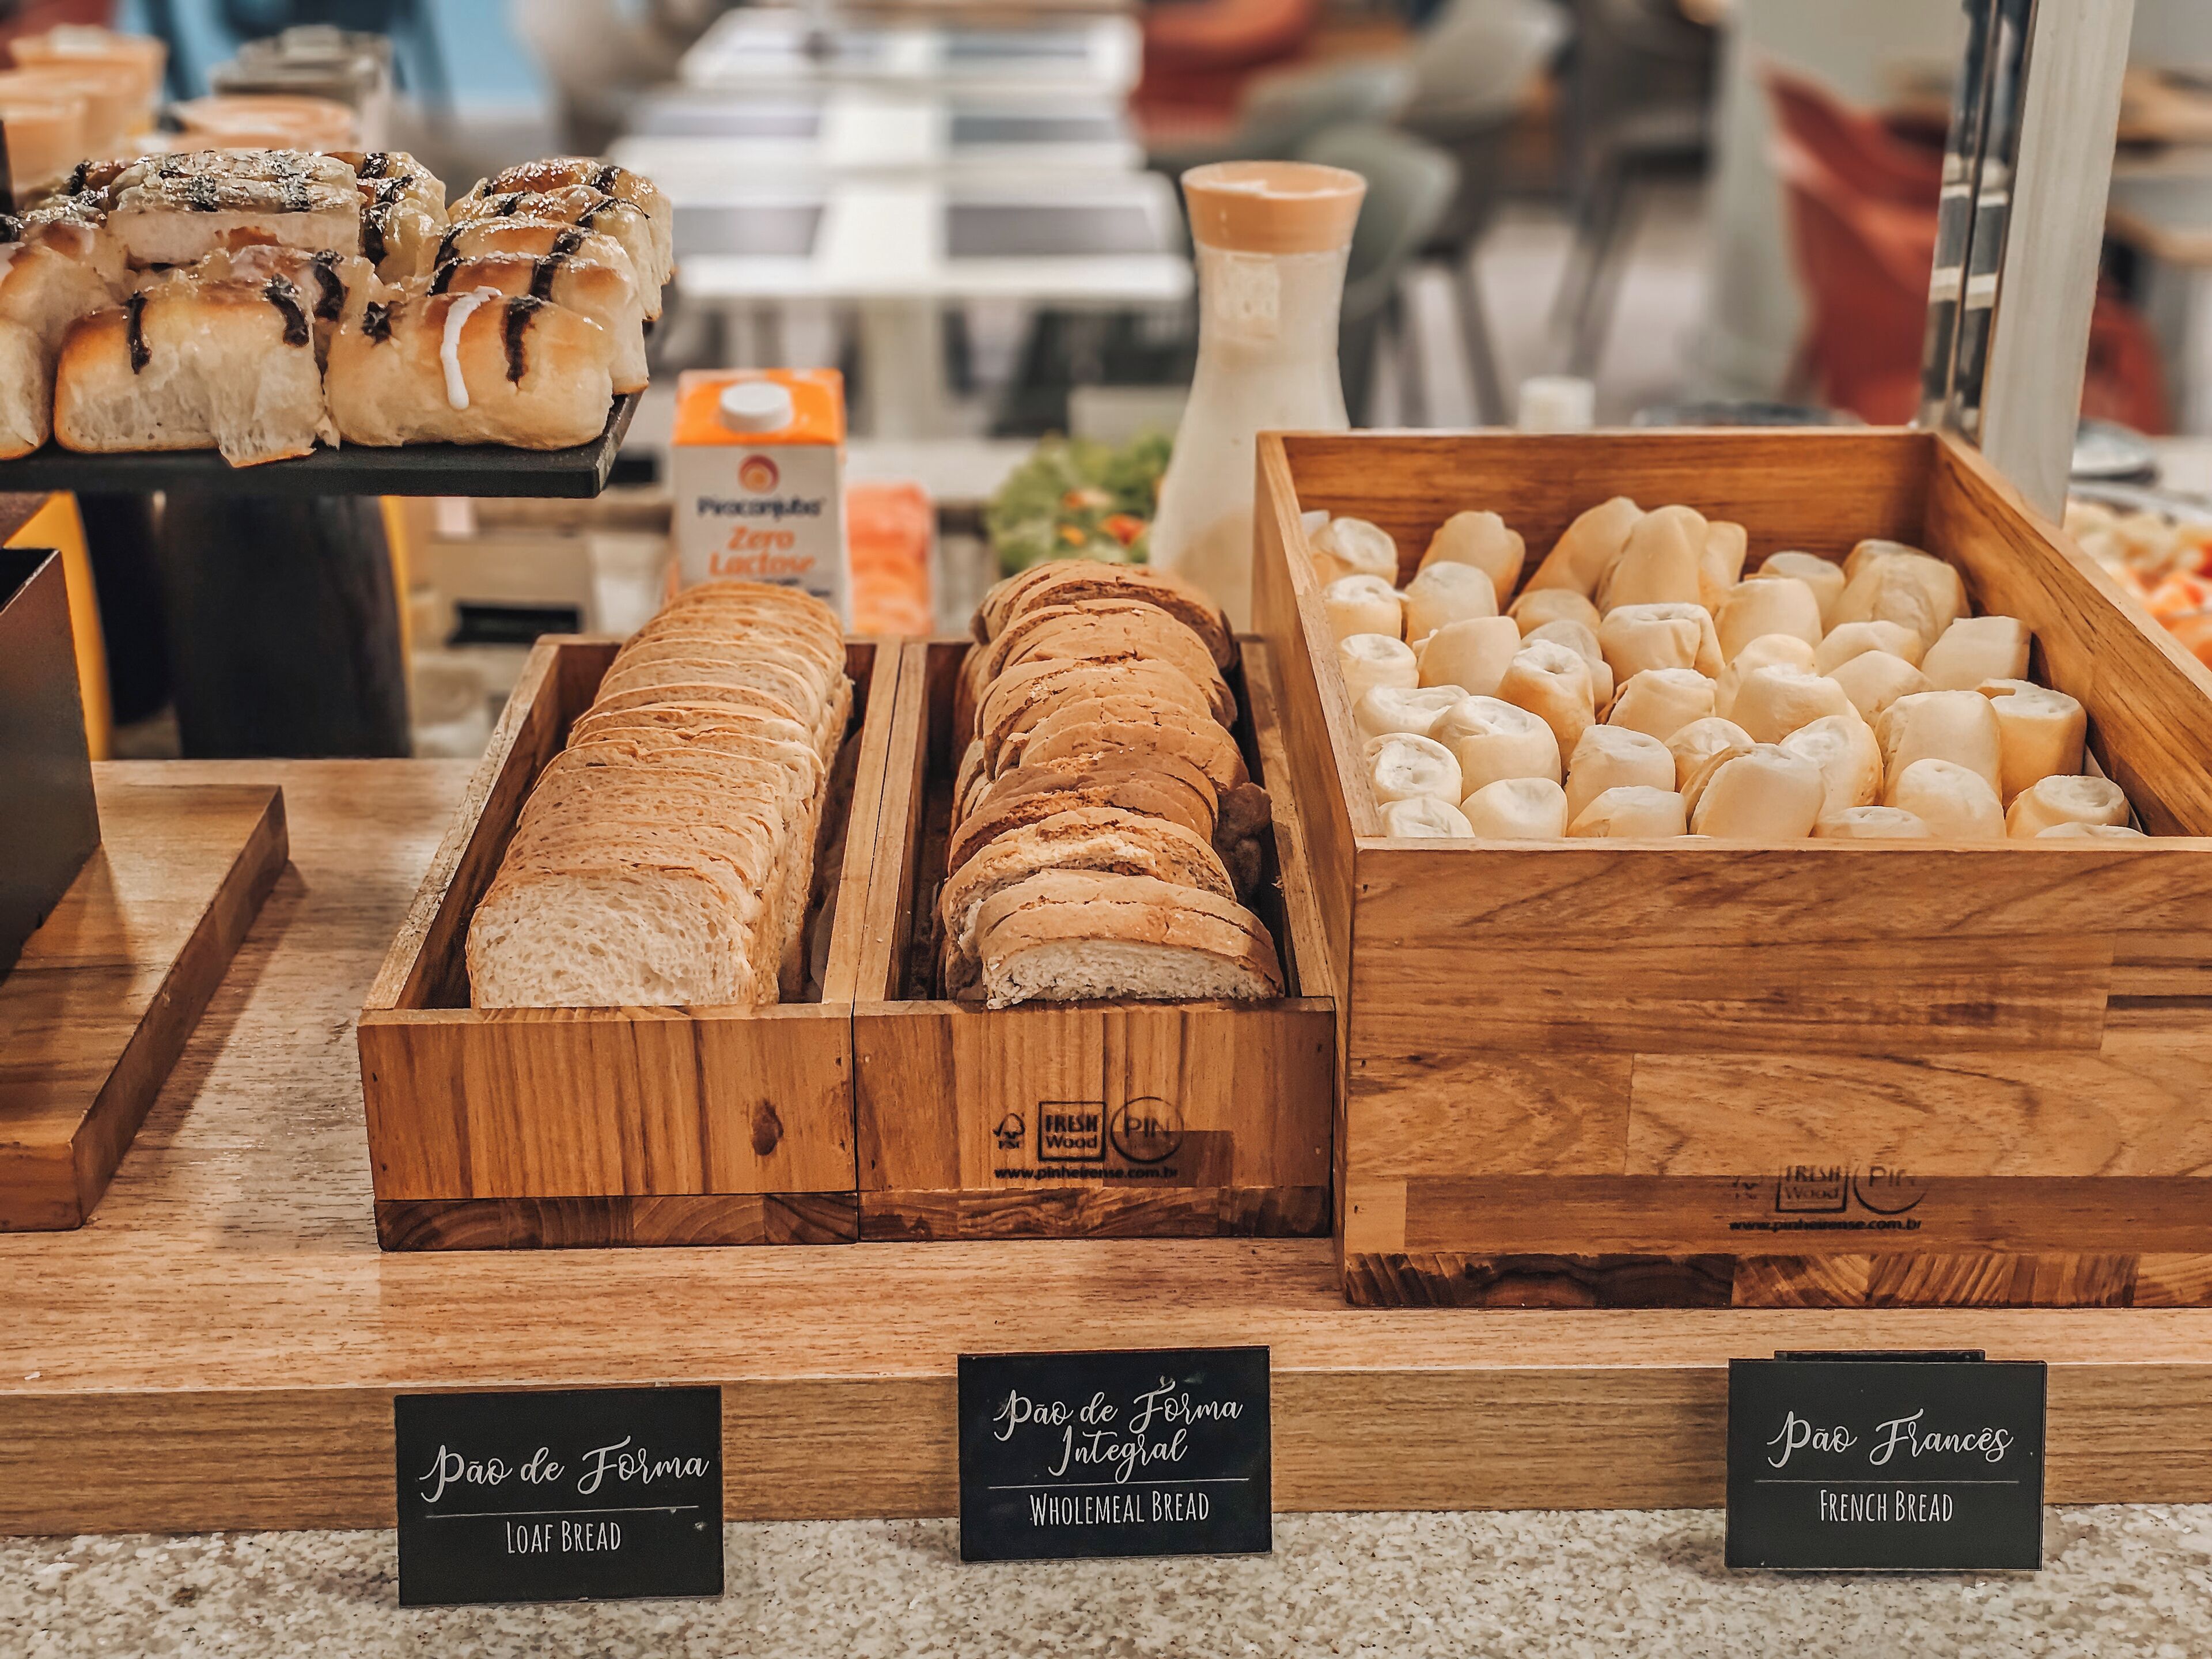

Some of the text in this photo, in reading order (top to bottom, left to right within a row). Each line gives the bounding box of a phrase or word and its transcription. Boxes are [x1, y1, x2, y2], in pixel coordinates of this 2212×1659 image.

[728, 527, 796, 550] Zero
[709, 552, 816, 576] Lactose
[1045, 1114, 1098, 1132] FRESH
[1046, 1135, 1098, 1149] Wood
[993, 1380, 1243, 1441] Pão de Forma
[1048, 1425, 1188, 1484] Integral
[1766, 1408, 2014, 1468] Pão Francês
[419, 1435, 710, 1502] Pão de Forma
[1030, 1490, 1210, 1527] WHOLEMEAL BREAD
[1820, 1489, 1953, 1522] FRENCH BREAD
[562, 1520, 621, 1553] BREAD
